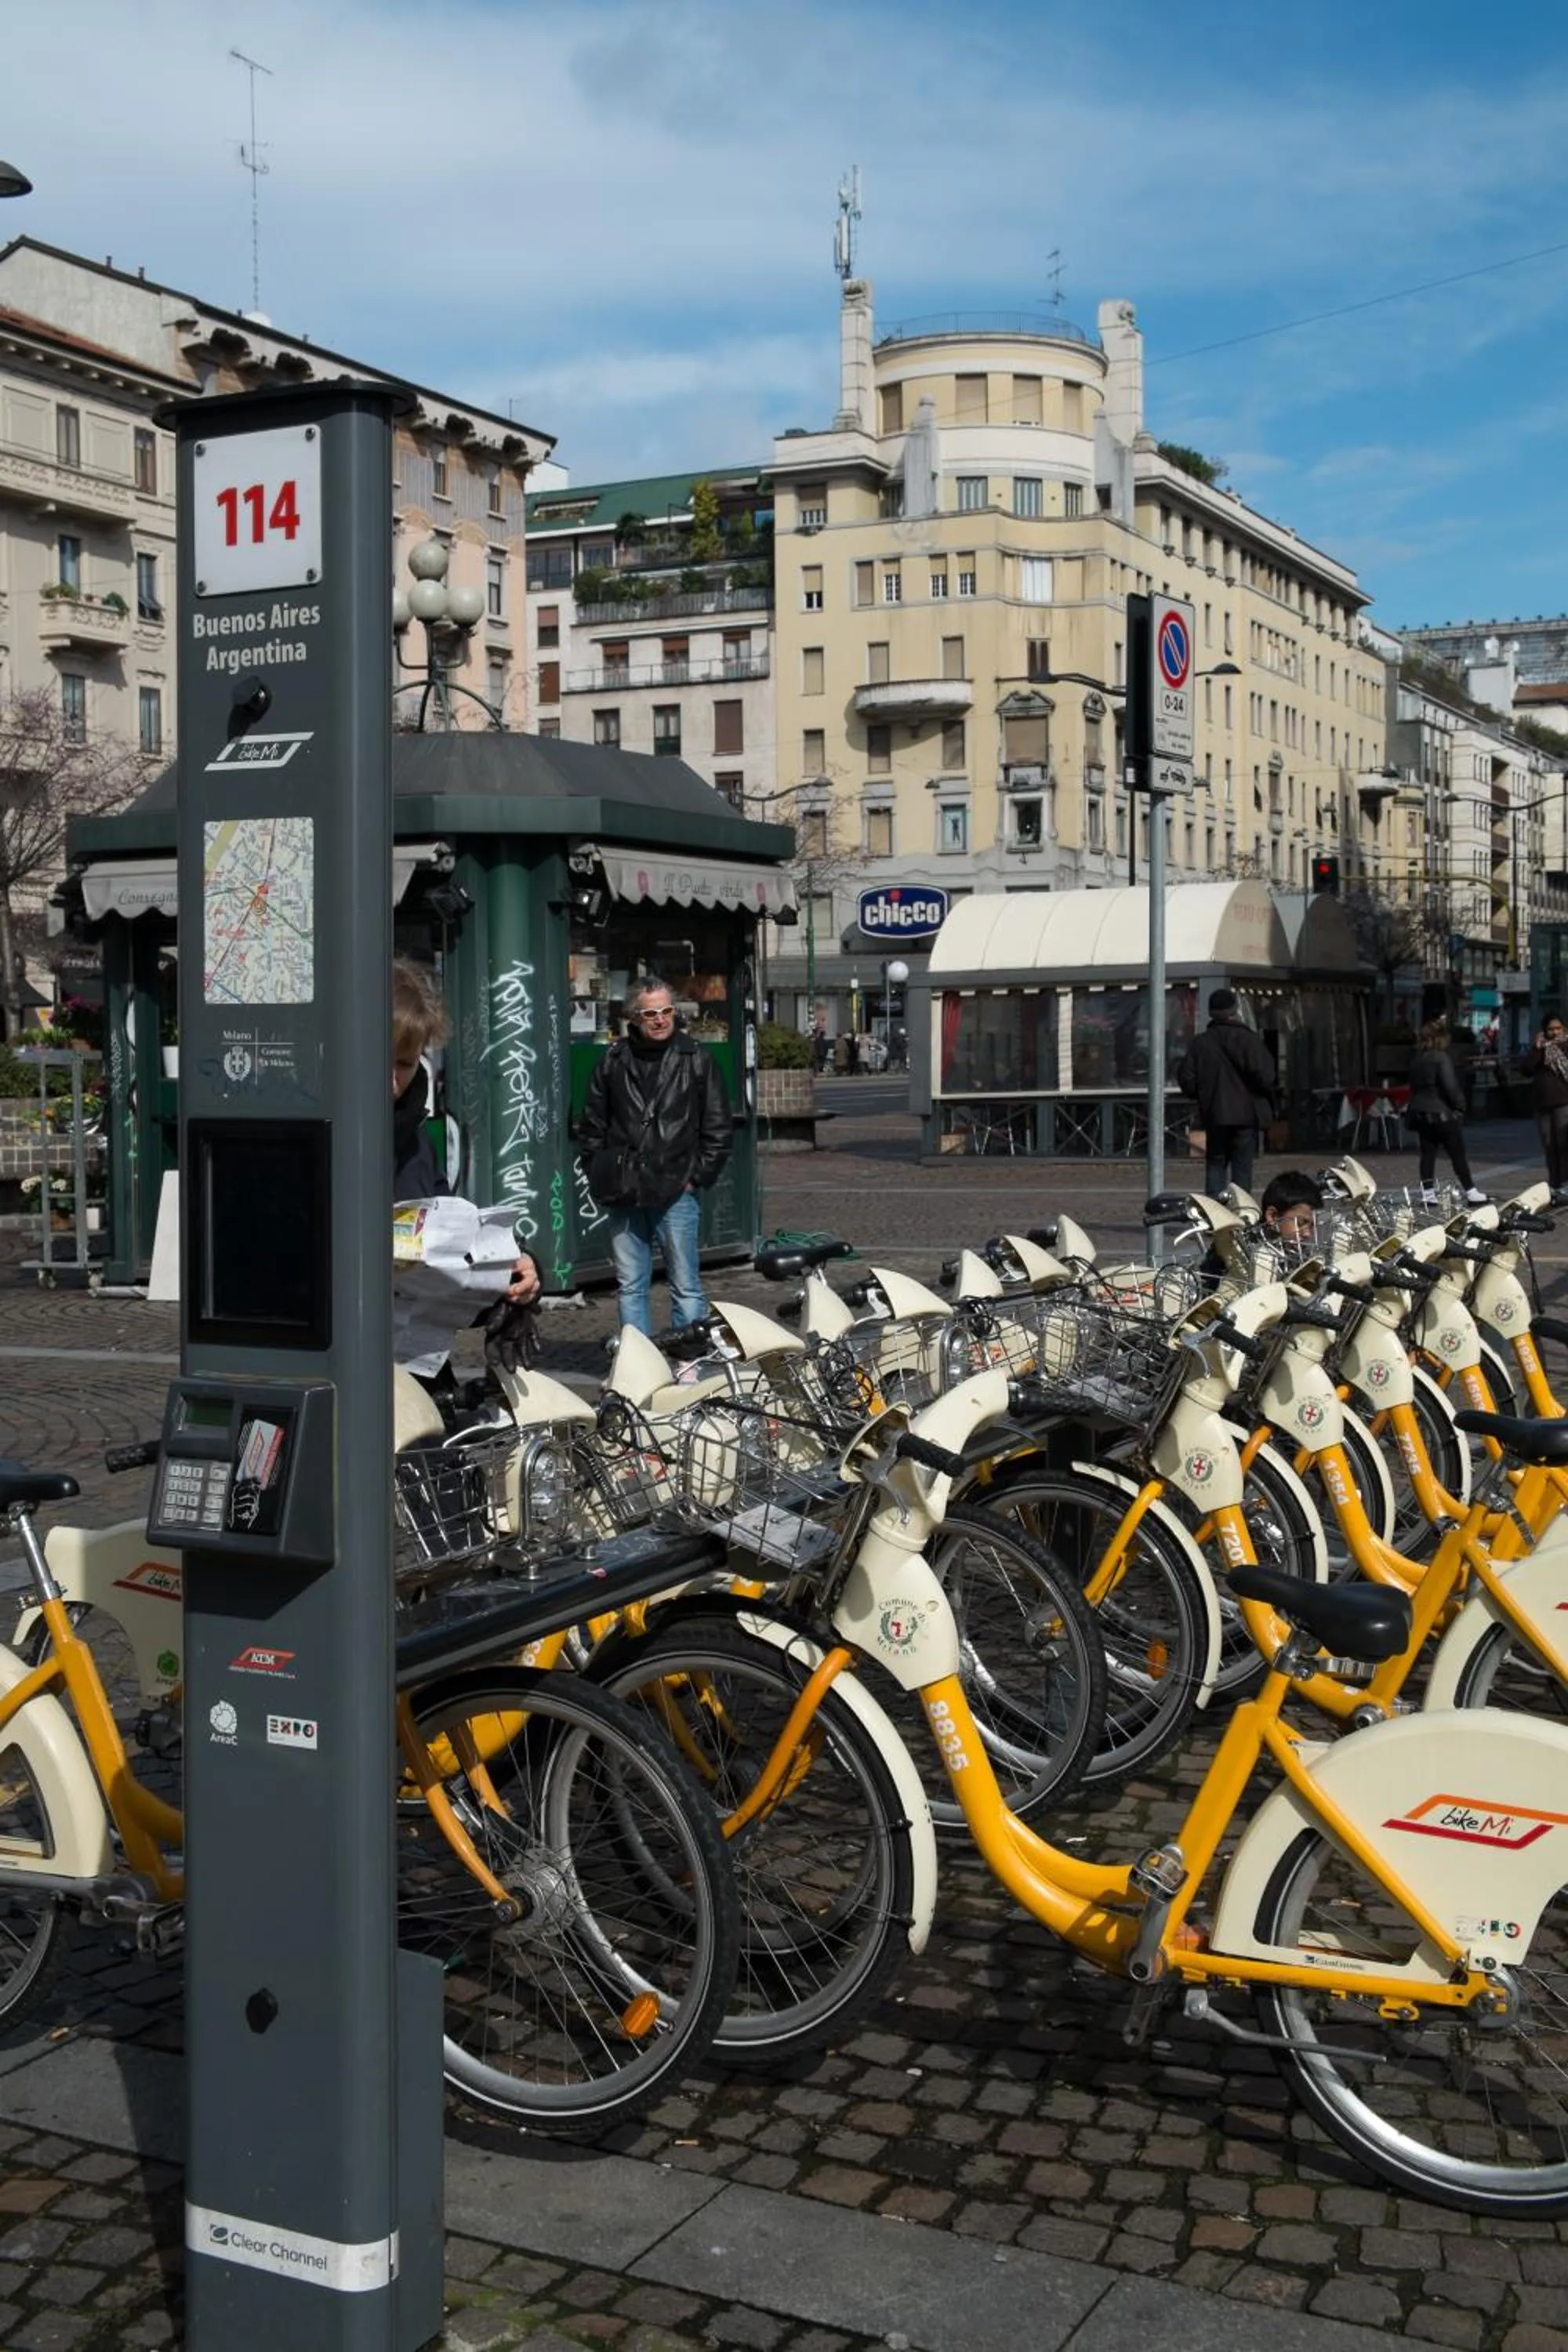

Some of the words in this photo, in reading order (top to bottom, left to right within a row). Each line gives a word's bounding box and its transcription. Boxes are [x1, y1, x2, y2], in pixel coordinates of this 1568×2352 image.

[216, 481, 300, 546] 114
[193, 609, 266, 638] Buenos
[270, 602, 321, 630] Aires
[206, 639, 307, 674] Argentina
[865, 889, 940, 927] chicco
[251, 1652, 275, 1665] ATM
[1440, 1806, 1515, 1837] bikeMi
[230, 2232, 267, 2254] Clear
[270, 2241, 328, 2270] Channel
